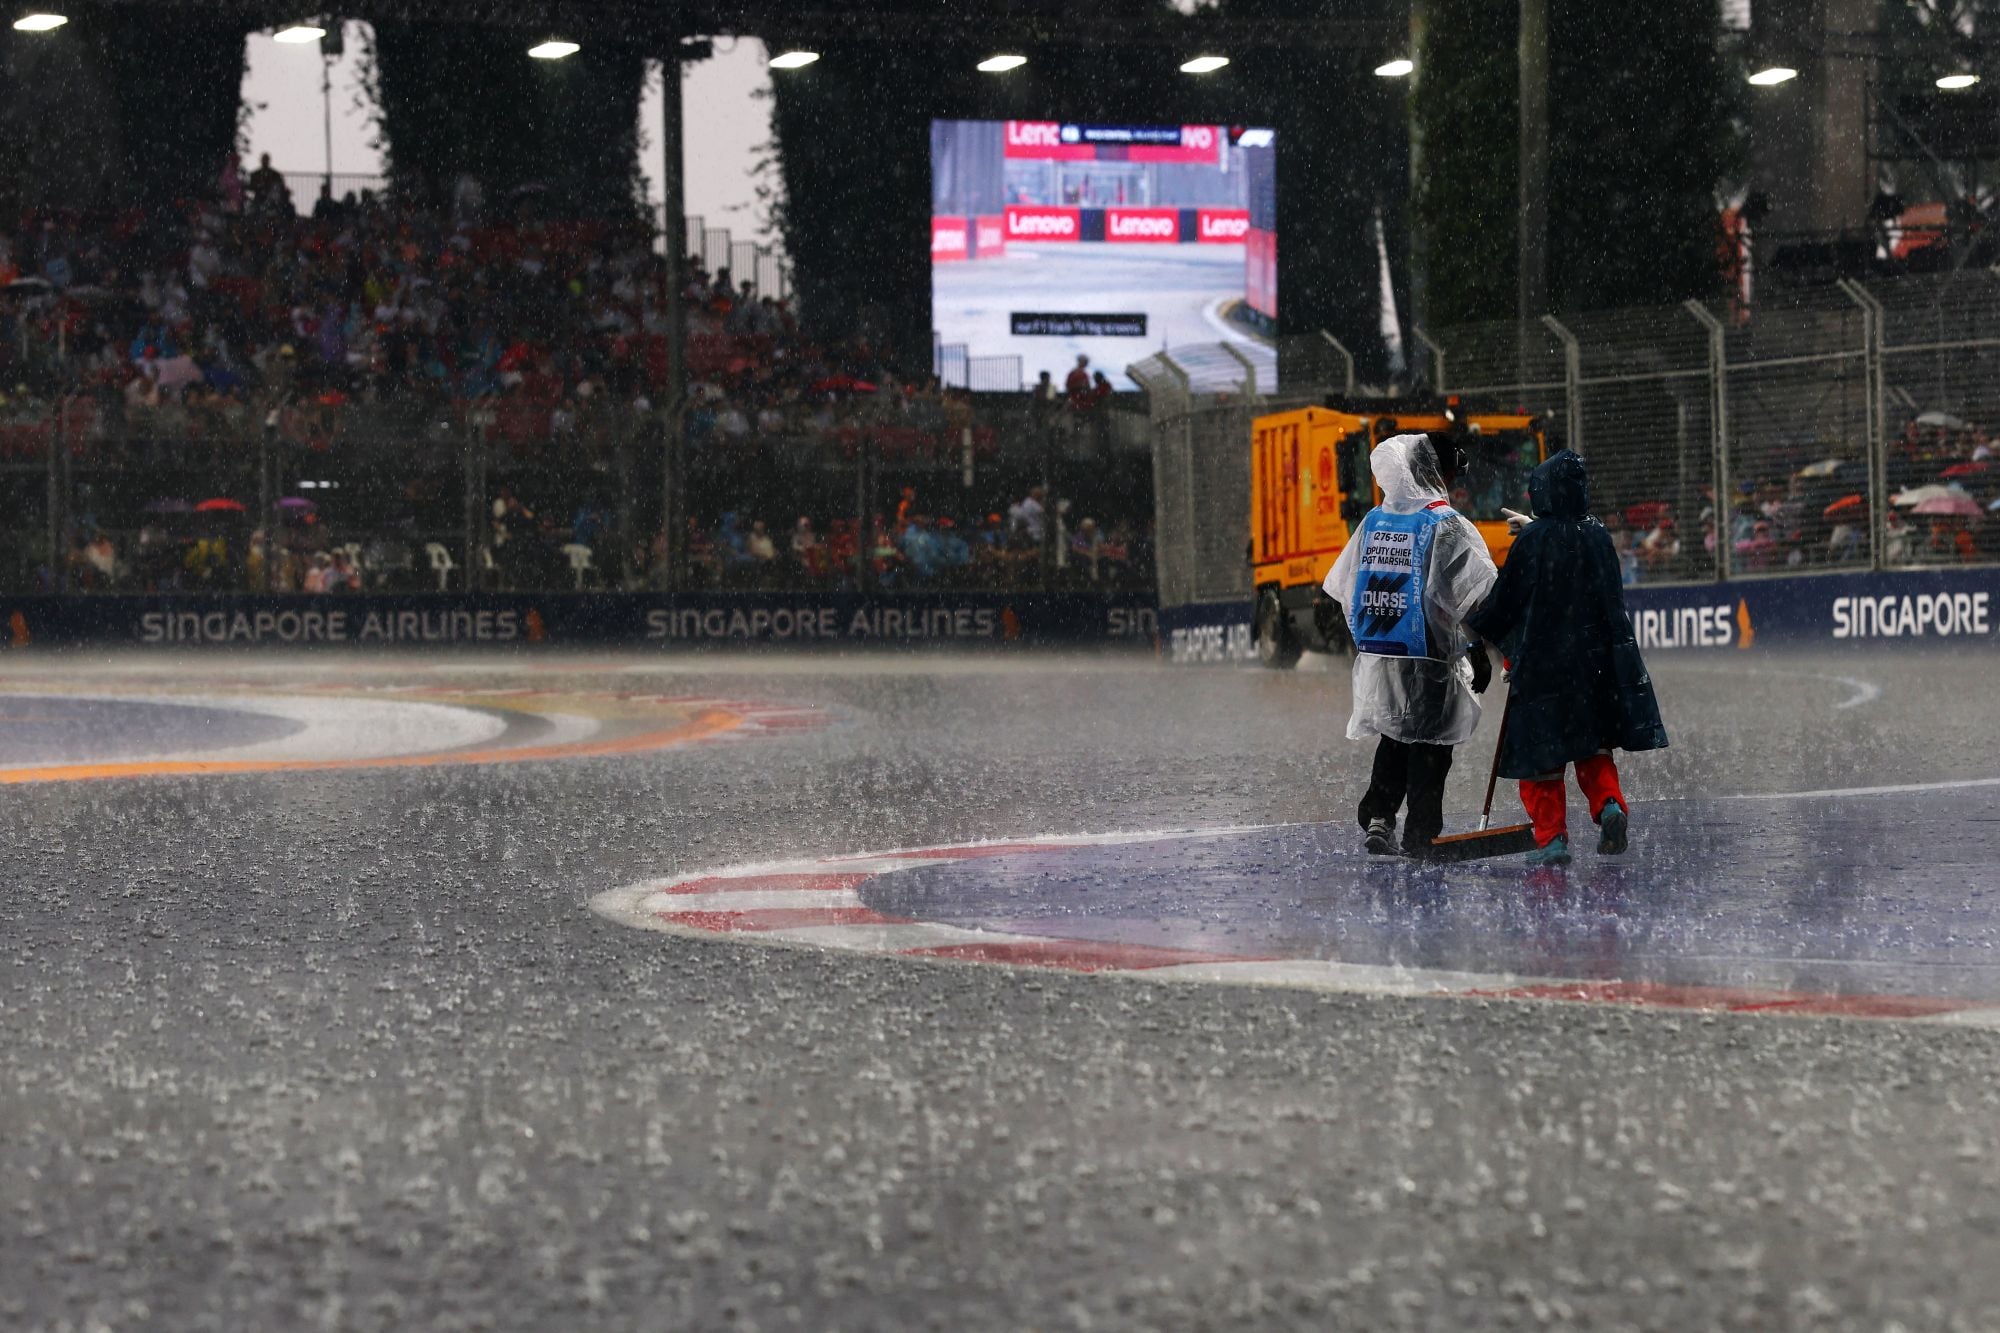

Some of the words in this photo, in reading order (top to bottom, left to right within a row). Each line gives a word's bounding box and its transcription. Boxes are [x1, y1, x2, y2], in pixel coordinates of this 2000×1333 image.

[1009, 212, 1075, 234] Lenovo
[1110, 213, 1174, 236] Lenovo
[1202, 214, 1249, 237] Leno
[646, 607, 836, 638] SINGAPORE
[848, 606, 995, 637] AIRLINES
[1366, 607, 1402, 617] CCESS
[1832, 592, 1990, 638] SINGAPORE
[141, 610, 348, 643] SINGAPORE
[359, 609, 518, 641] AIRLINES
[1634, 605, 1732, 650] IRLINES
